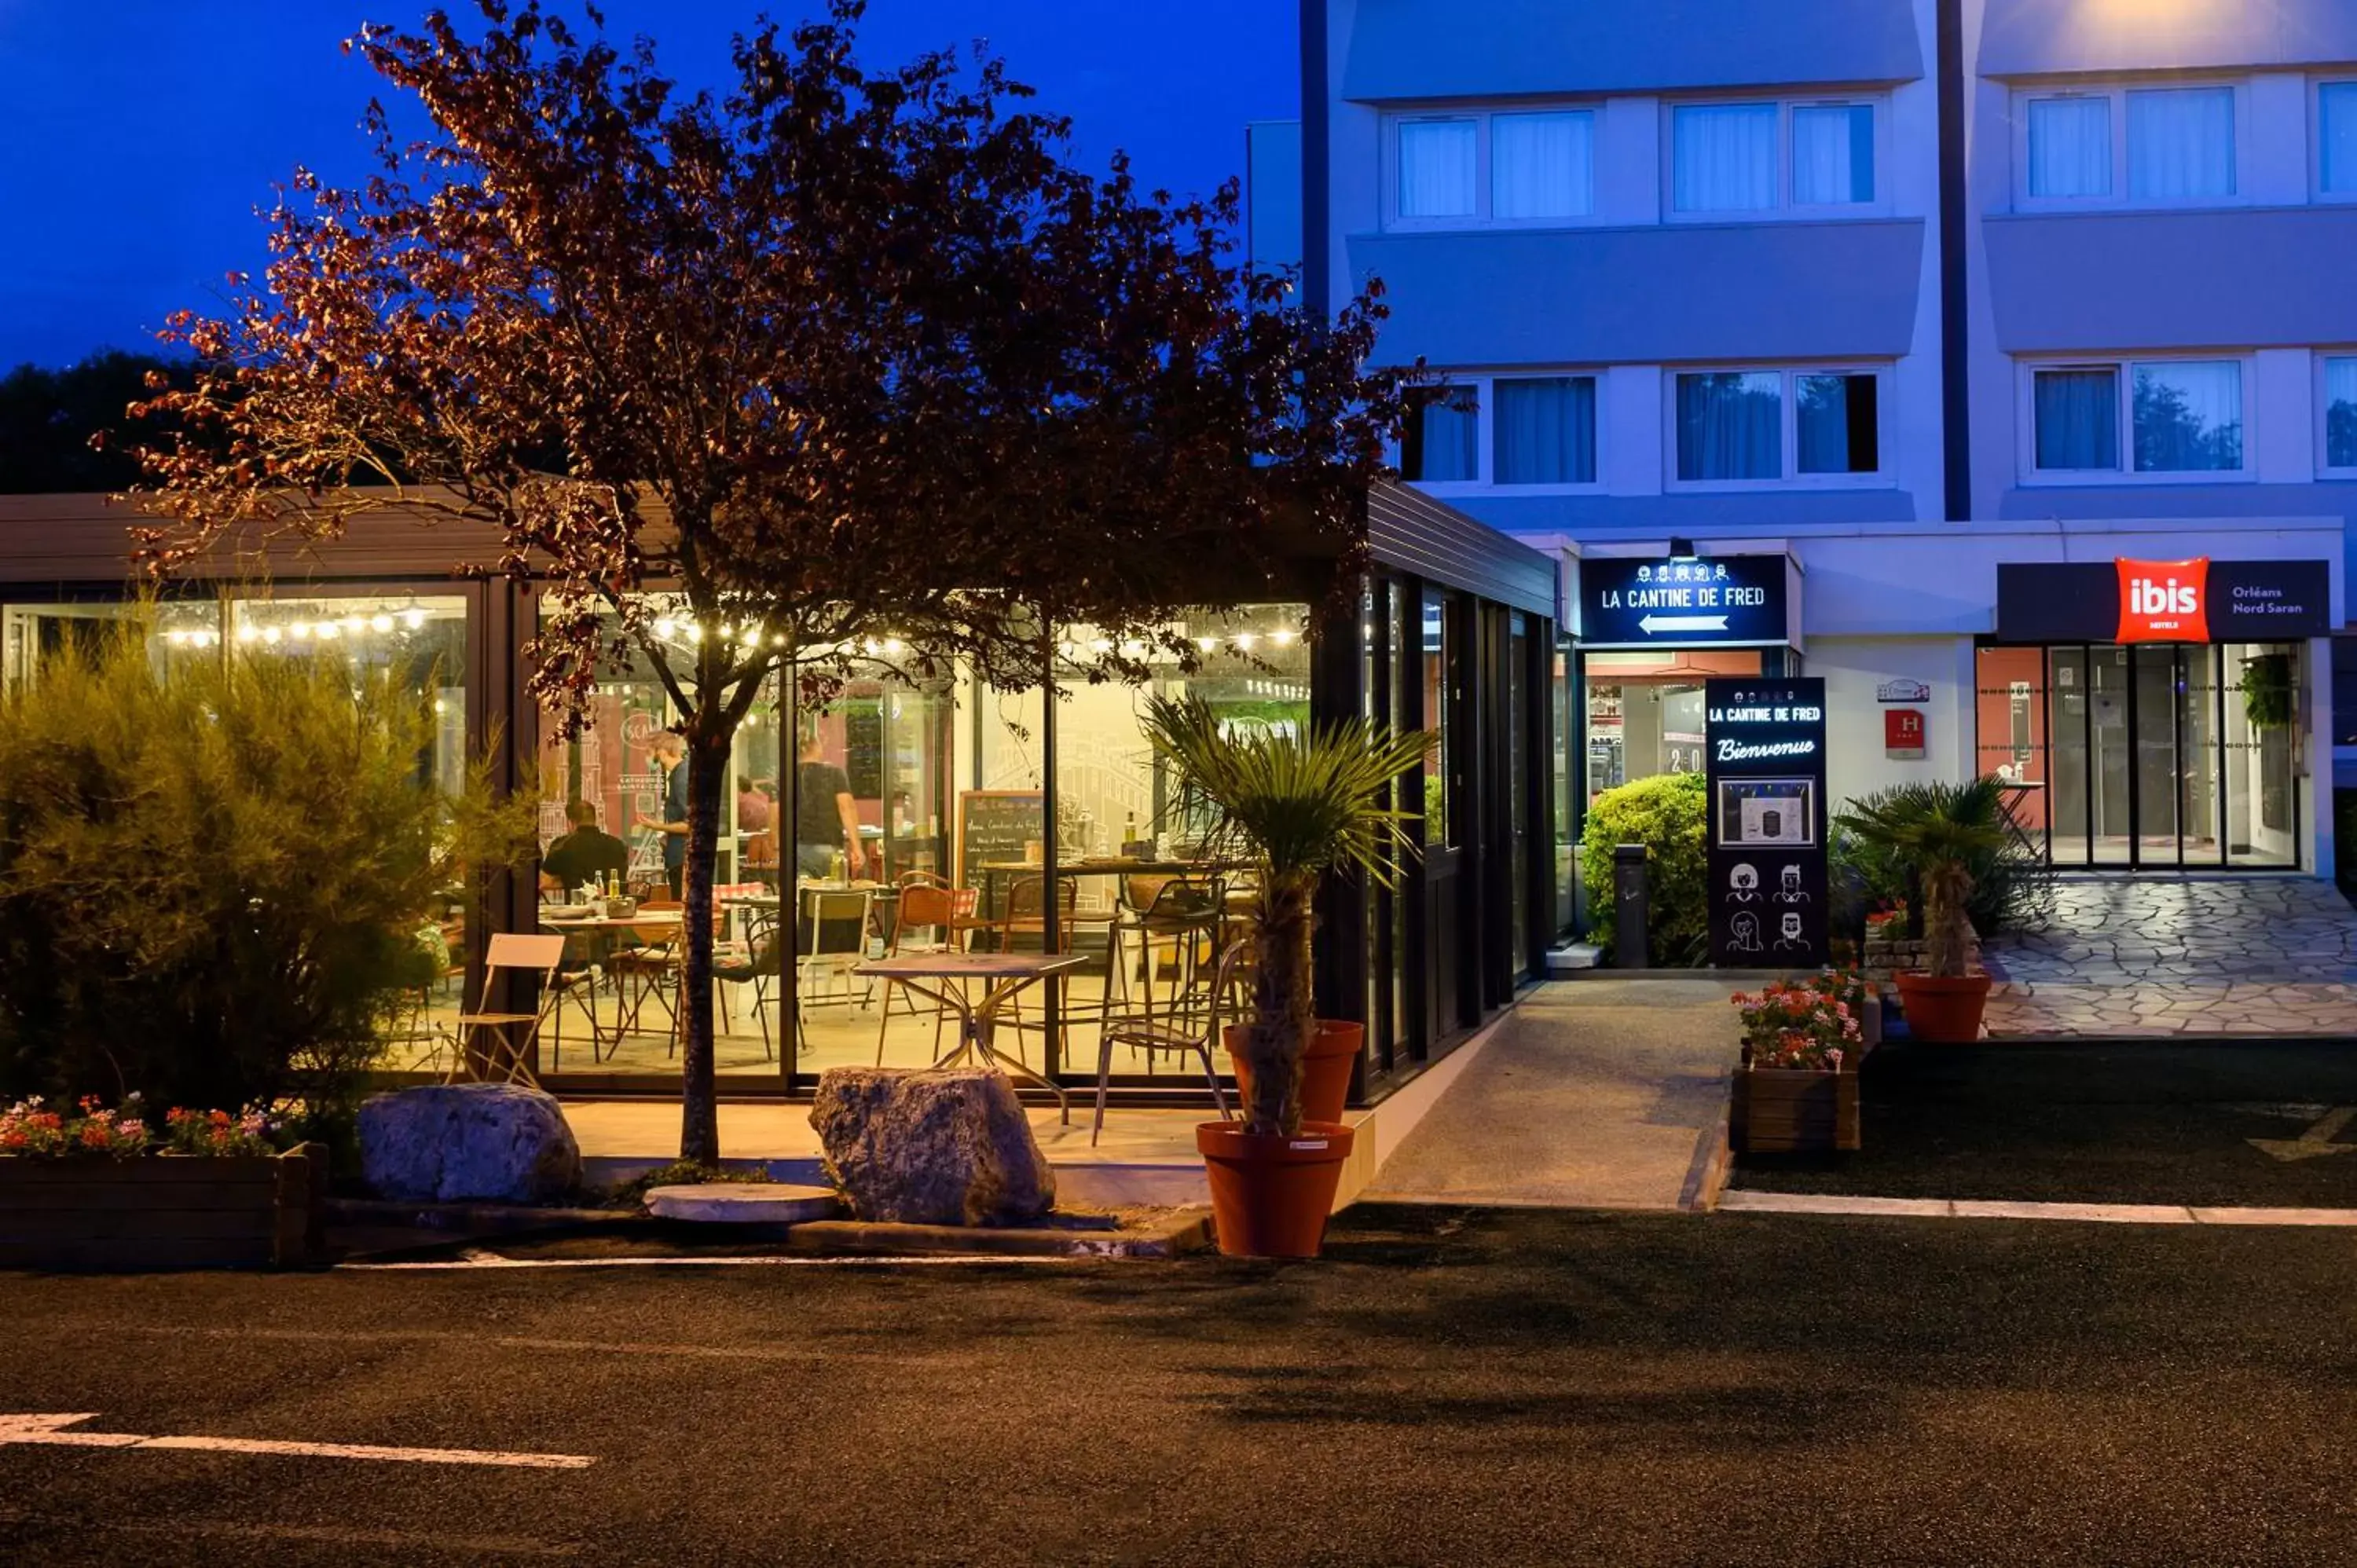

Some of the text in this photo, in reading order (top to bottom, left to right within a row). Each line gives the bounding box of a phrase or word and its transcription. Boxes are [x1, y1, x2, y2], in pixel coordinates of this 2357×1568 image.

[1602, 587, 1765, 609] LA CANTINE DE FRED
[2130, 577, 2198, 614] ibis
[2232, 587, 2282, 599] Orléans
[2232, 603, 2303, 614] Nord Saran
[1709, 706, 1821, 722] LA CANTINE DE FRED
[1902, 716, 1919, 731] H
[1717, 738, 1815, 761] Bienvenue
